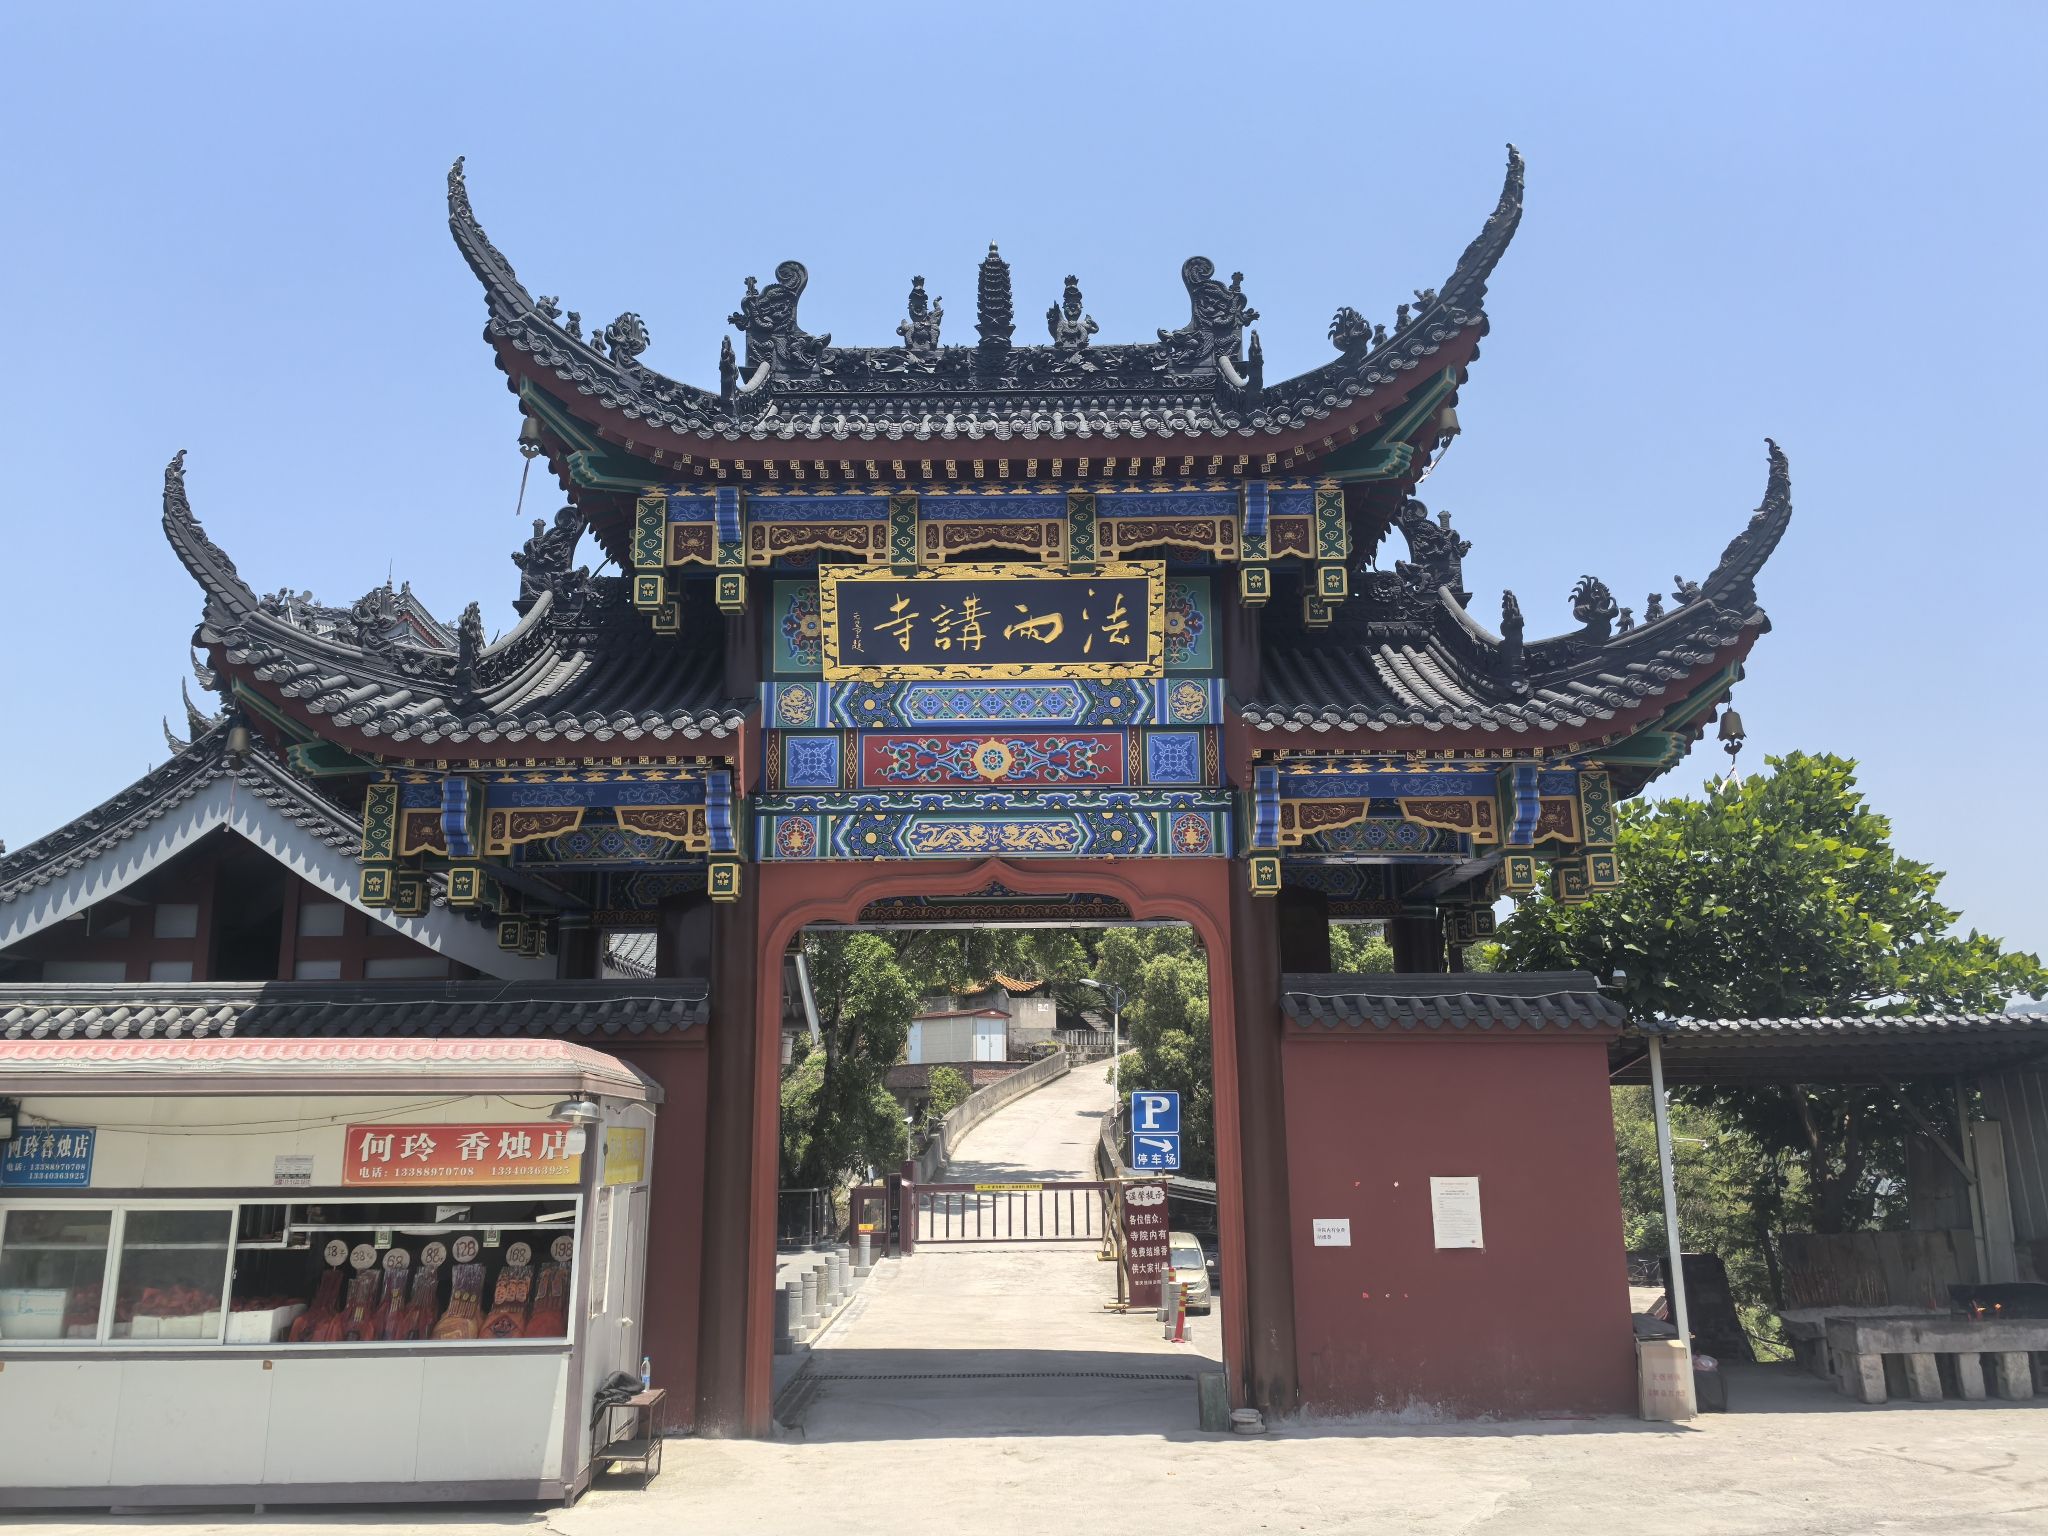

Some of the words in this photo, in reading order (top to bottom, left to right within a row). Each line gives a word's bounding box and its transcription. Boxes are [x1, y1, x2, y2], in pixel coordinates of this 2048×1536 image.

[1141, 1096, 1170, 1129] P
[359, 1131, 437, 1162] 何玲
[455, 1130, 570, 1161] 香烛店
[1137, 1153, 1176, 1165] 停车场
[30, 1163, 86, 1171] 13388970708
[394, 1167, 475, 1177] 13388970708
[491, 1166, 570, 1176] 13340363925
[29, 1172, 85, 1180] 13340363925
[1128, 1190, 1162, 1201] 温馨提示
[1129, 1229, 1167, 1241] 寺院内有
[456, 1240, 476, 1258] 128
